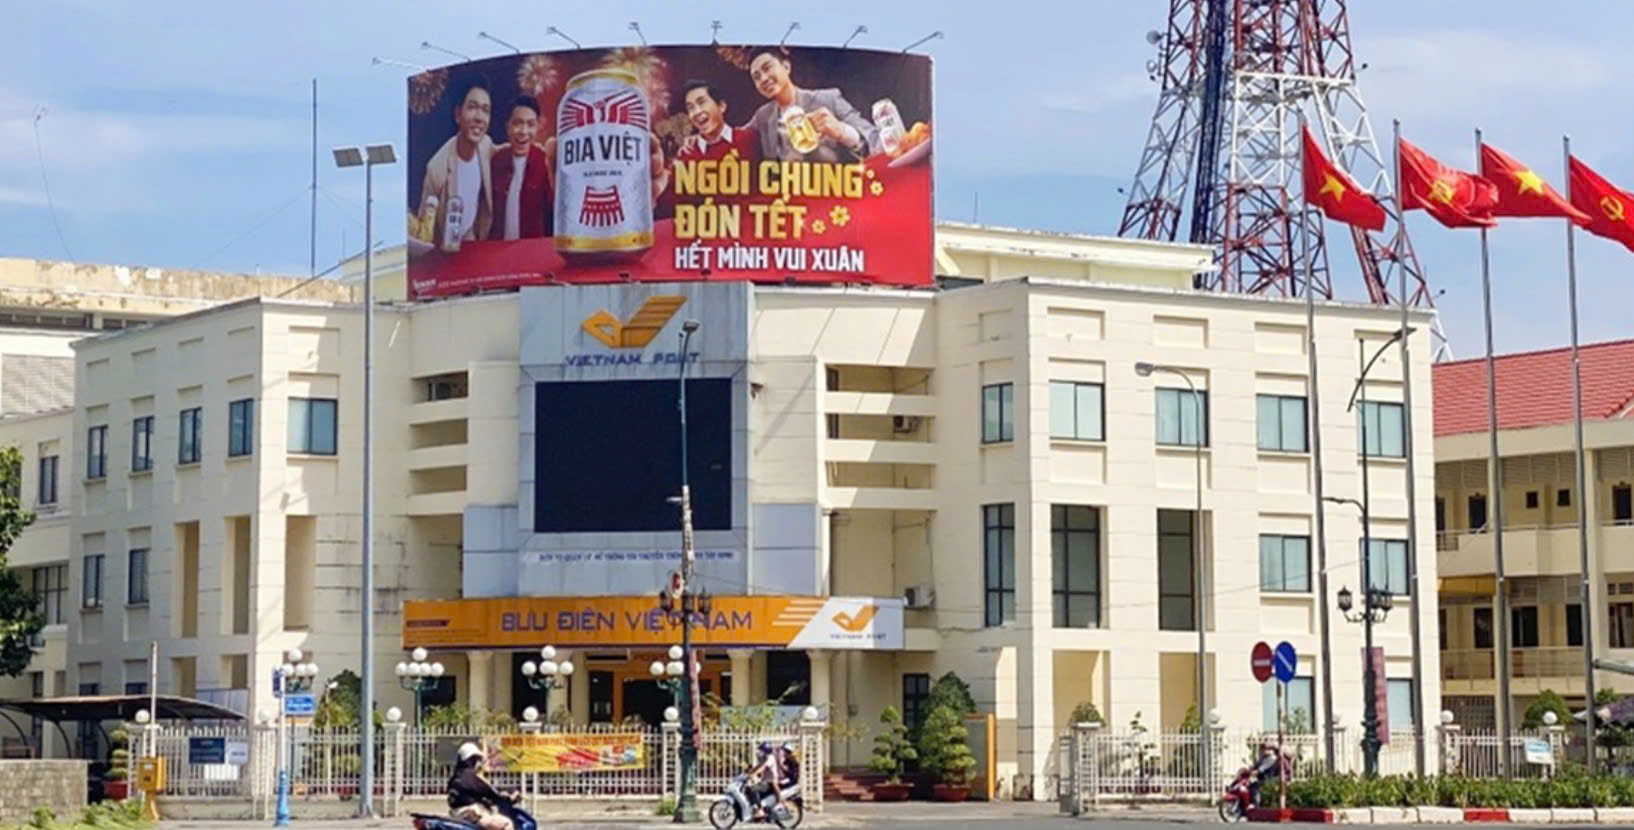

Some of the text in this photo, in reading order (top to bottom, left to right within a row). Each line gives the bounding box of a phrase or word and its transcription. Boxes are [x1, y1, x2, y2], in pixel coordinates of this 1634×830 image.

[564, 131, 642, 165] BIA VIỆT
[674, 148, 864, 197] NGỒI CHUNG
[674, 193, 807, 239] ĐÓN TẾT
[675, 238, 864, 272] HẾT MÌNH VUI XUÂN
[565, 353, 642, 366] VIETNAM
[557, 607, 615, 635] ĐIỆN
